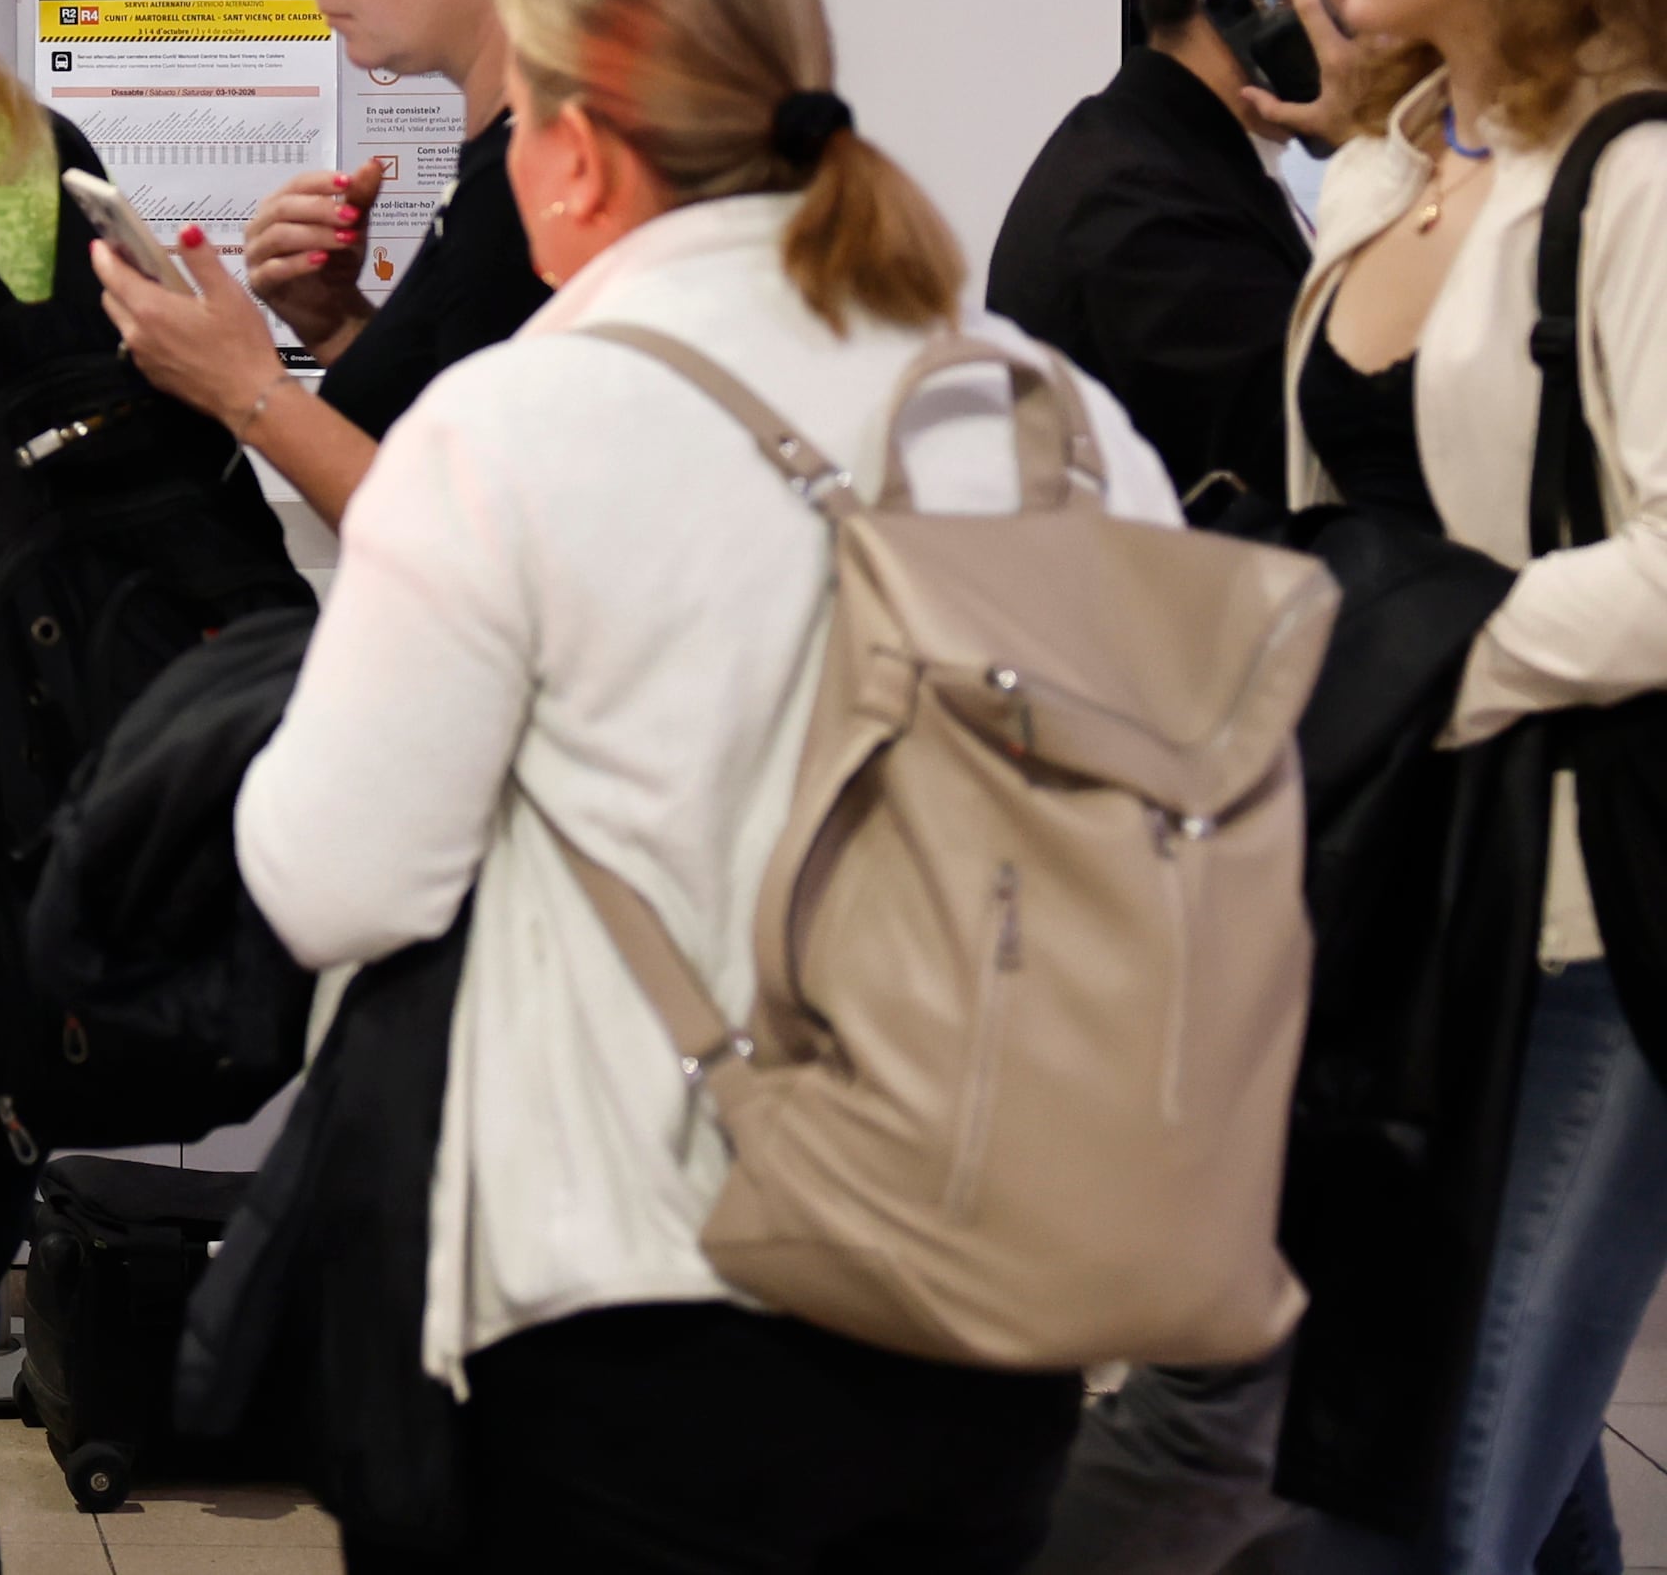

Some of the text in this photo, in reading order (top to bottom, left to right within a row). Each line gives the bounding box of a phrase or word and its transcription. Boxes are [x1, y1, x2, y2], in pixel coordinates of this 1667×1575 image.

[61, 9, 77, 18] R2
[81, 10, 99, 21] R4
[104, 14, 127, 22] CUNIT
[135, 14, 179, 22] MARTORELL
[181, 14, 215, 22] CENTRAL
[245, 13, 273, 23] VICENÇ
[288, 13, 322, 21] CALDERS
[378, 106, 393, 116] què
[395, 106, 441, 114] consisteix?
